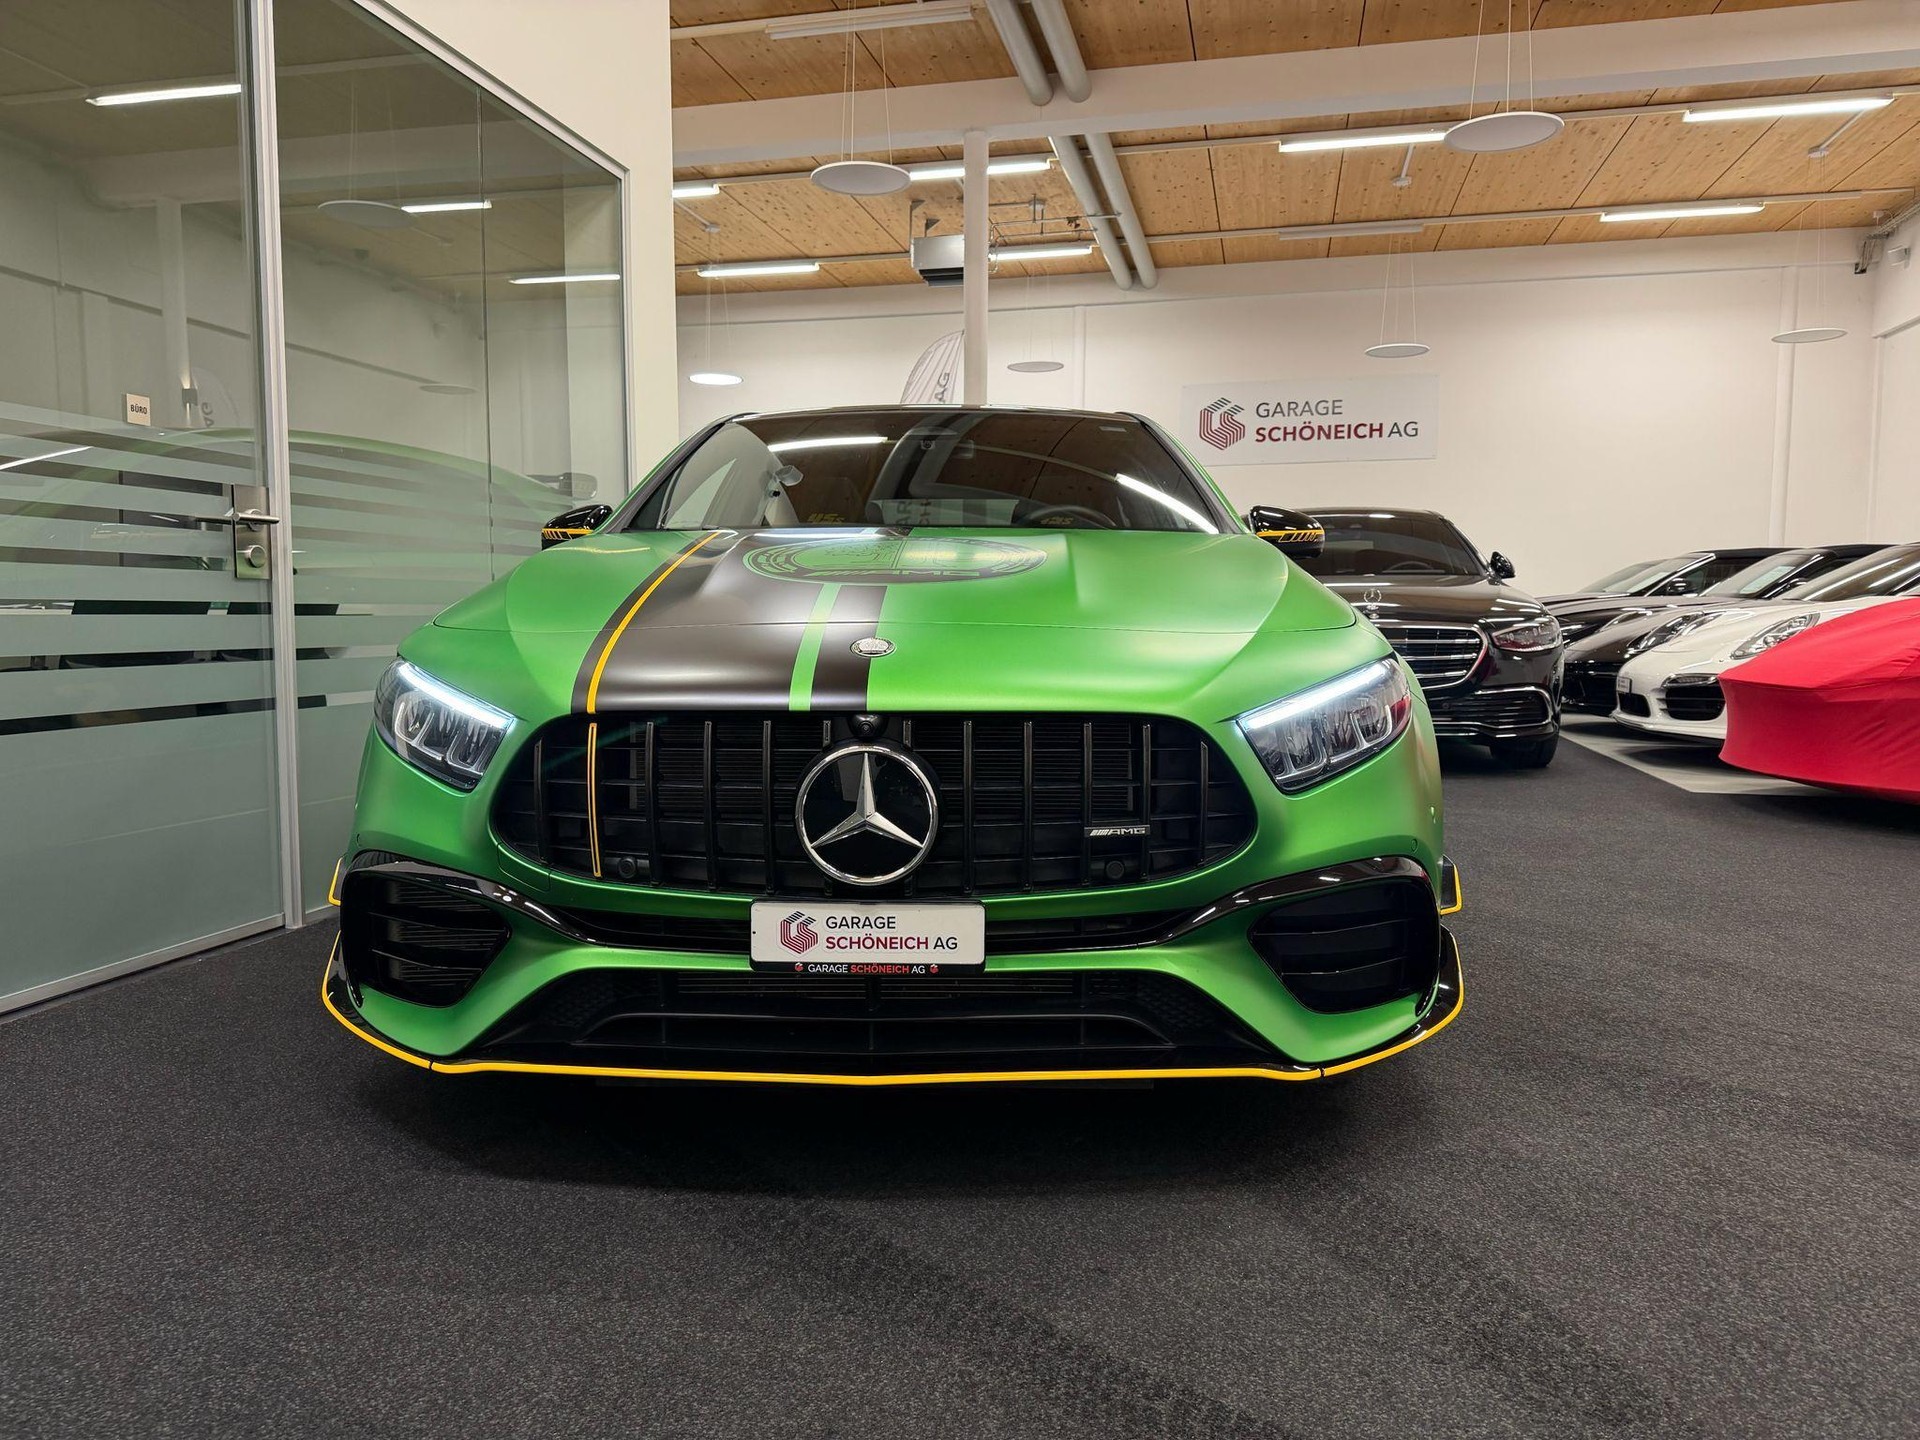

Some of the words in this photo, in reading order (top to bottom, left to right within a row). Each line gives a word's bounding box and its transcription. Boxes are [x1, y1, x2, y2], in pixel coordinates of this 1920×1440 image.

[130, 404, 148, 415] BÜRO
[1256, 400, 1343, 418] GARAGE
[1255, 421, 1384, 443] SCHÖNEICH
[1388, 421, 1418, 438] AG
[826, 916, 896, 929] GARAGE
[826, 933, 929, 950] SCHÖNEICH
[933, 936, 958, 950] AG
[808, 964, 848, 973] GARAGE
[850, 963, 909, 974] SCHÖNEICH
[911, 965, 926, 974] AG
